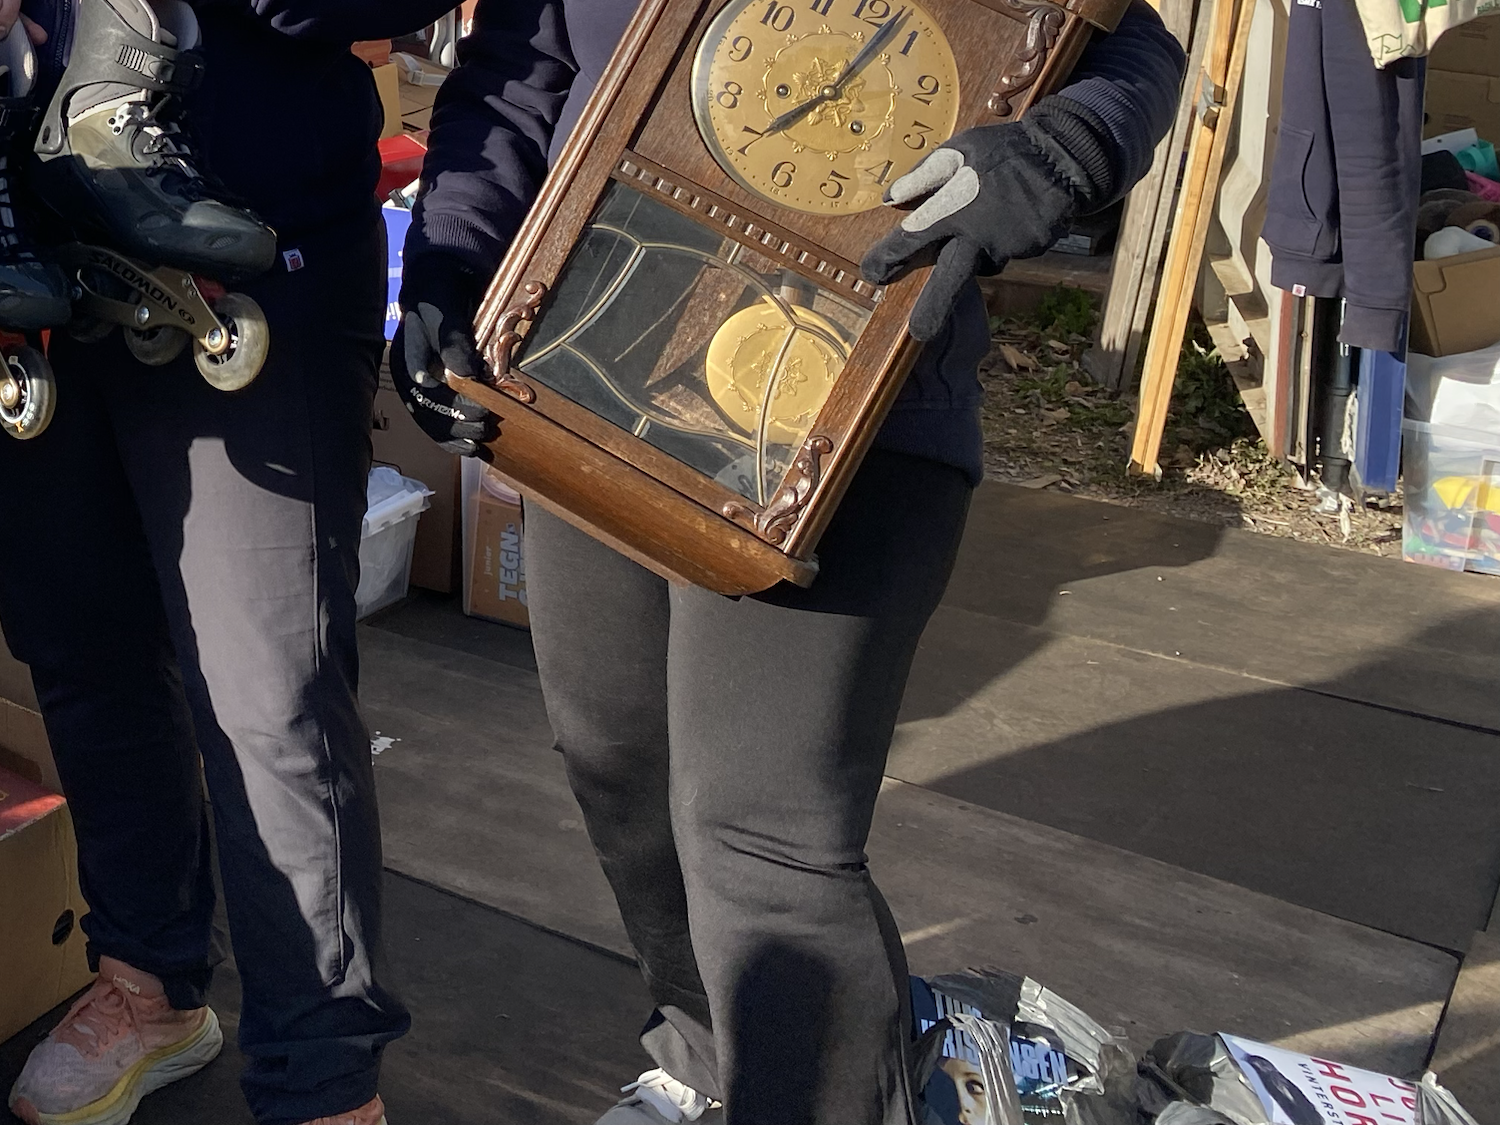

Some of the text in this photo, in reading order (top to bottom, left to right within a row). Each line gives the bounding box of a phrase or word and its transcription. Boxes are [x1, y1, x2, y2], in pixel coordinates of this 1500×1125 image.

[759, 0, 796, 32] 10
[728, 35, 754, 63] 9
[898, 30, 920, 57] 1
[716, 81, 744, 109] 8
[911, 74, 940, 106] 2
[736, 125, 765, 157] 7
[902, 120, 934, 150] 3
[771, 161, 797, 188] 6
[819, 170, 851, 199] 5
[865, 159, 895, 187] 4
[87, 251, 177, 311] SALOMON
[483, 545, 494, 577] junior
[499, 530, 521, 602] TEGN
